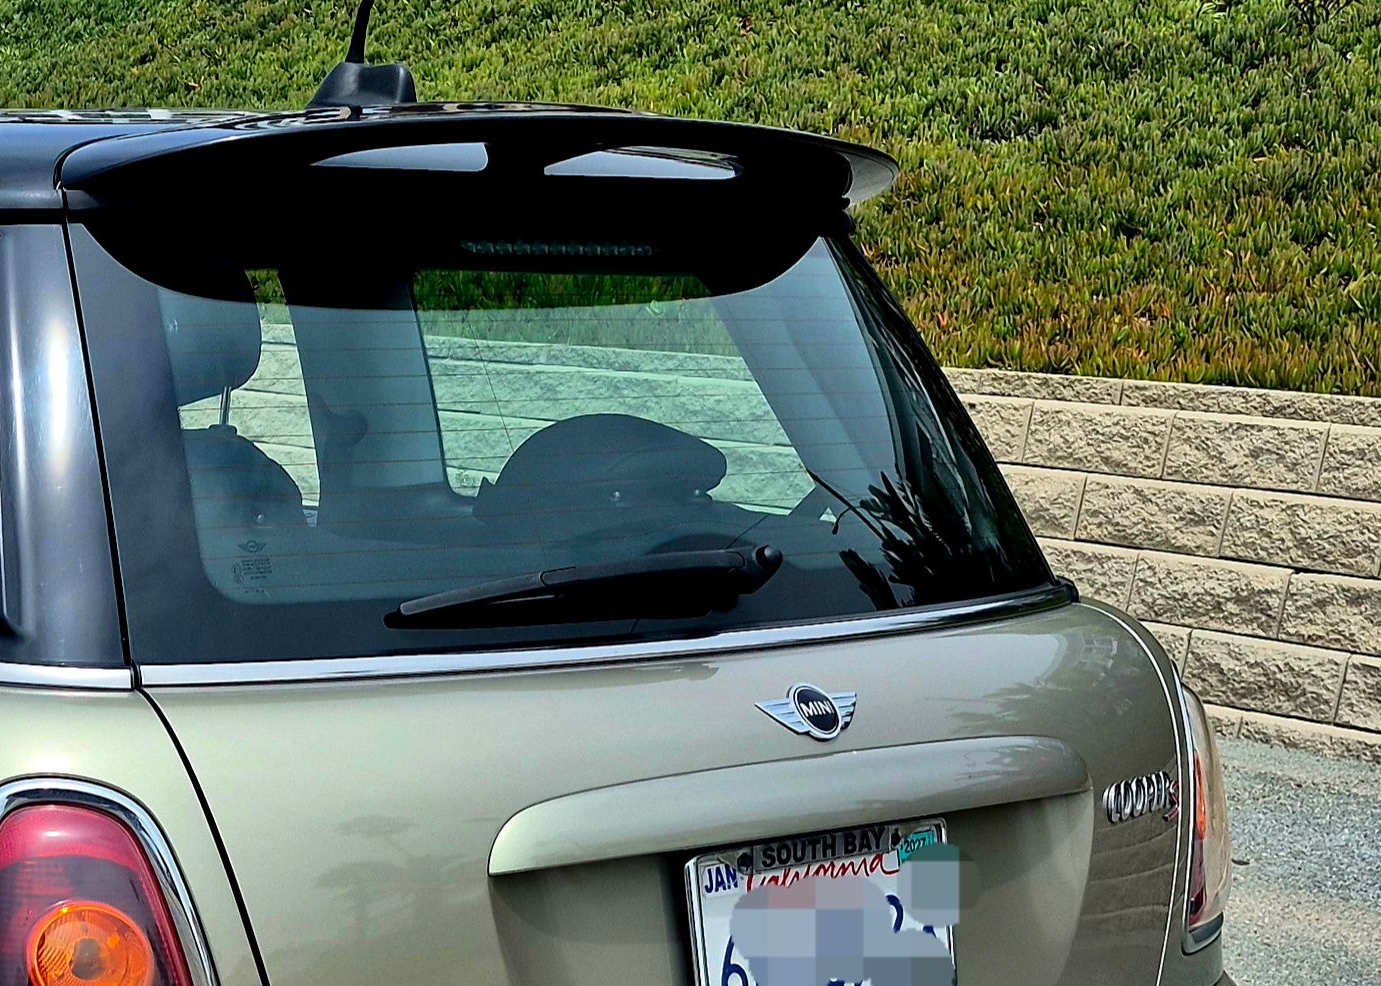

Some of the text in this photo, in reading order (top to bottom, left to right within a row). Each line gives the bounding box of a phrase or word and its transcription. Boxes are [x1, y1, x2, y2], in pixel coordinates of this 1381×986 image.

[800, 701, 835, 717] MINI
[761, 826, 886, 868] SOUTH BAY
[704, 863, 738, 893] JAN
